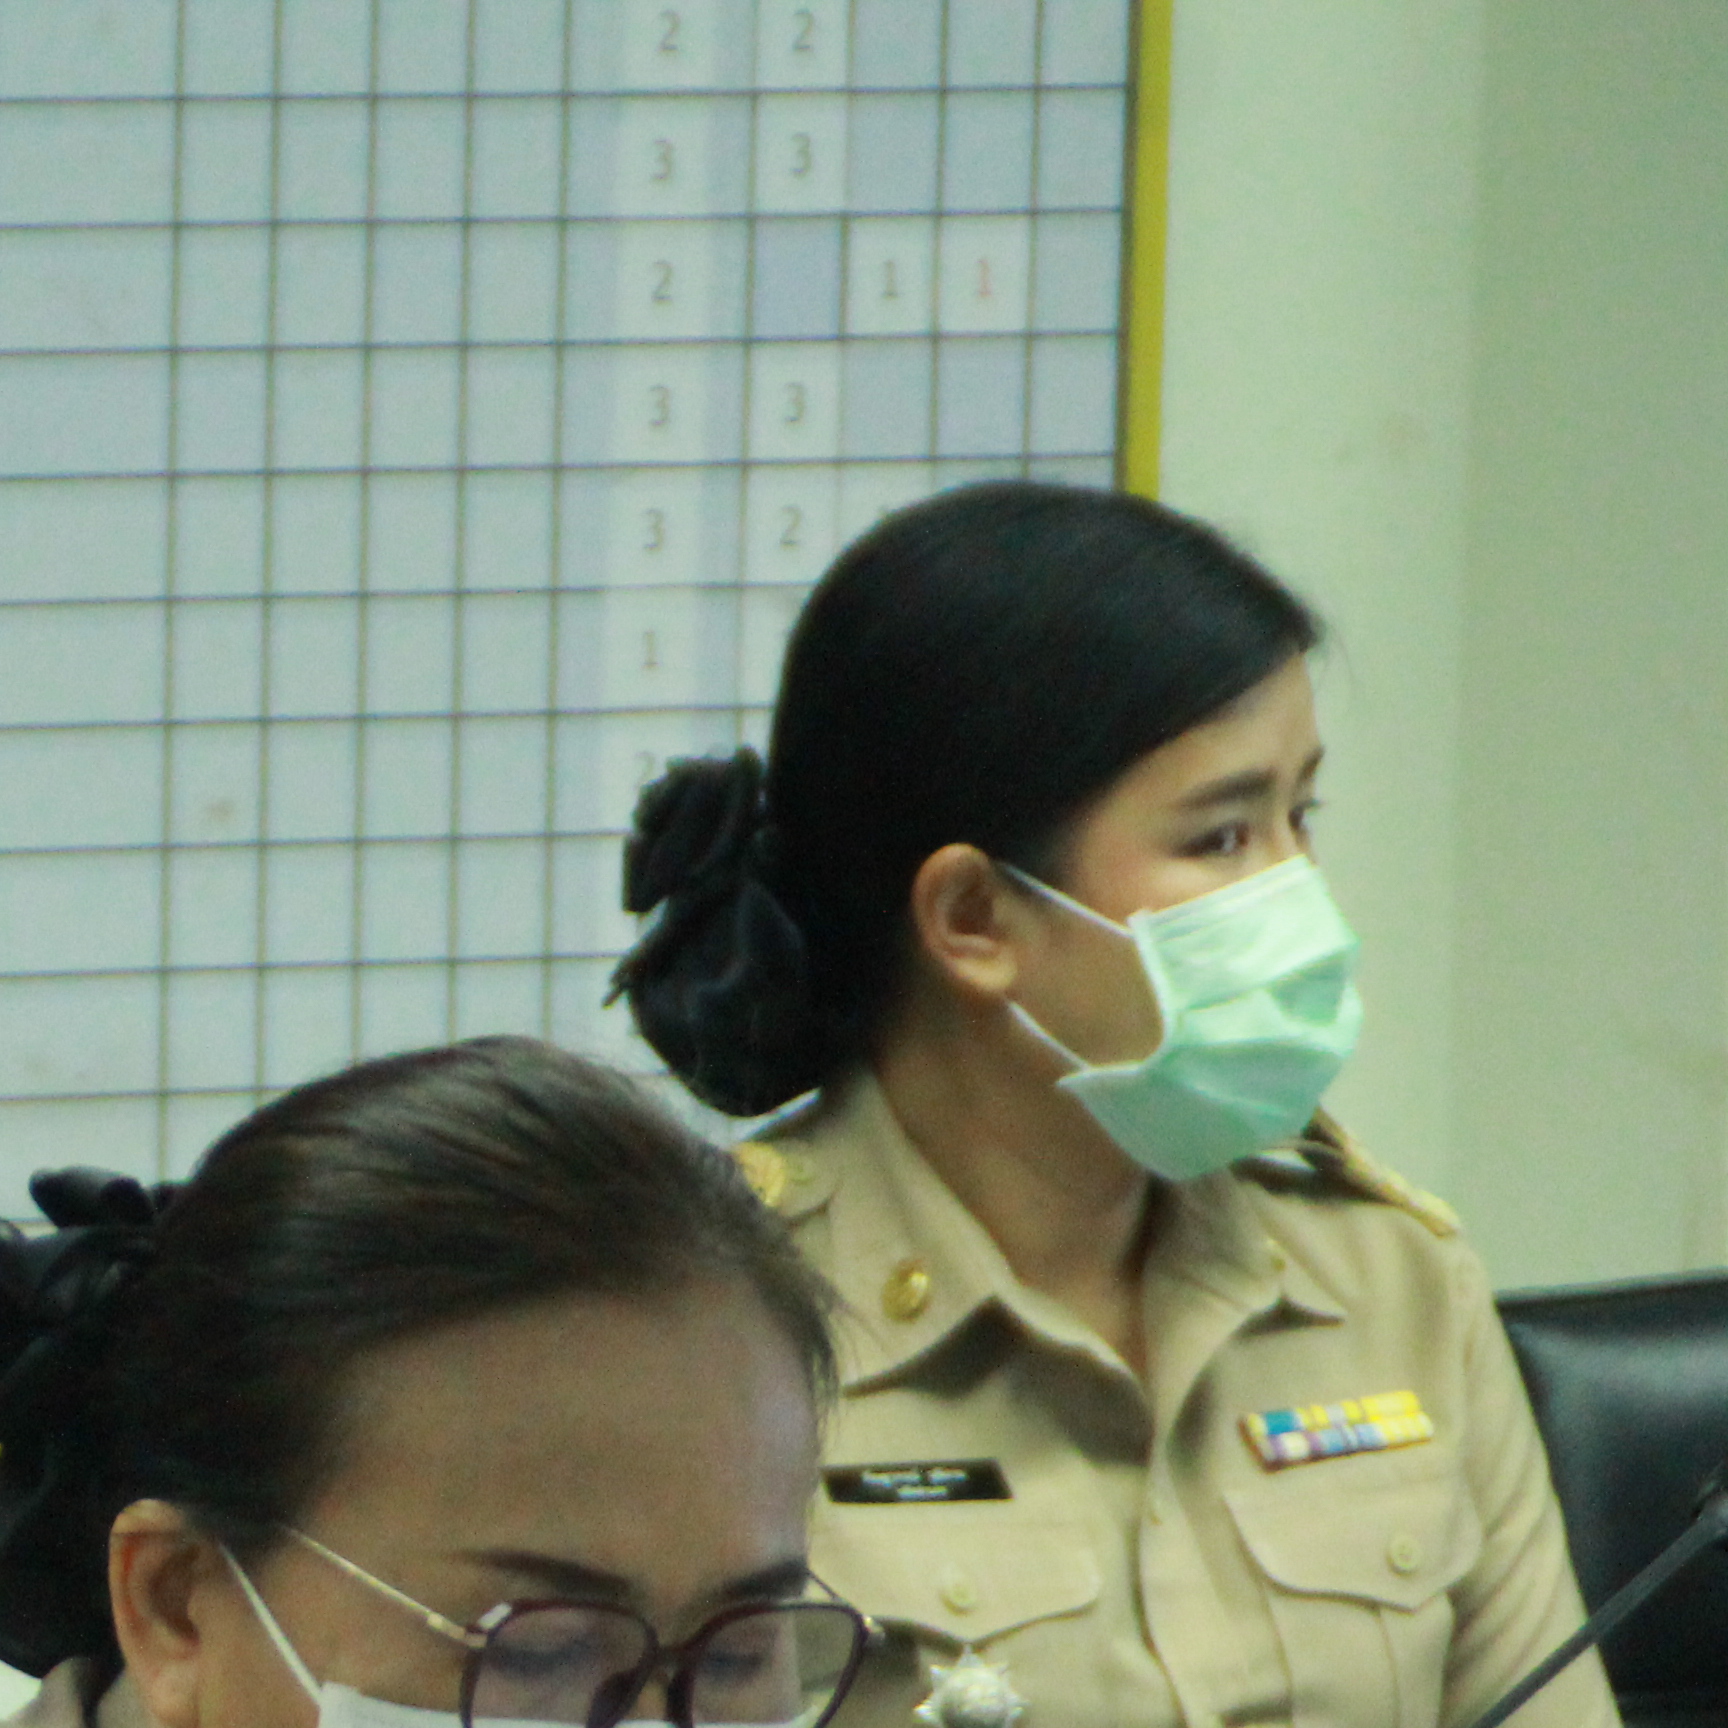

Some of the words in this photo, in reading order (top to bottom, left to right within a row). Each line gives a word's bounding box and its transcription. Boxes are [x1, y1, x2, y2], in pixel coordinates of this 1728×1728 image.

[658, 9, 683, 58] 2
[791, 7, 816, 57] 2
[650, 138, 677, 187] 3
[790, 132, 814, 181] 3
[651, 259, 675, 308] 2
[880, 259, 901, 303] 1
[973, 256, 993, 302] 1
[648, 383, 673, 432] 3
[783, 381, 808, 430] 3
[642, 507, 667, 556] 3
[778, 505, 803, 552] 2
[641, 629, 660, 673] 1
